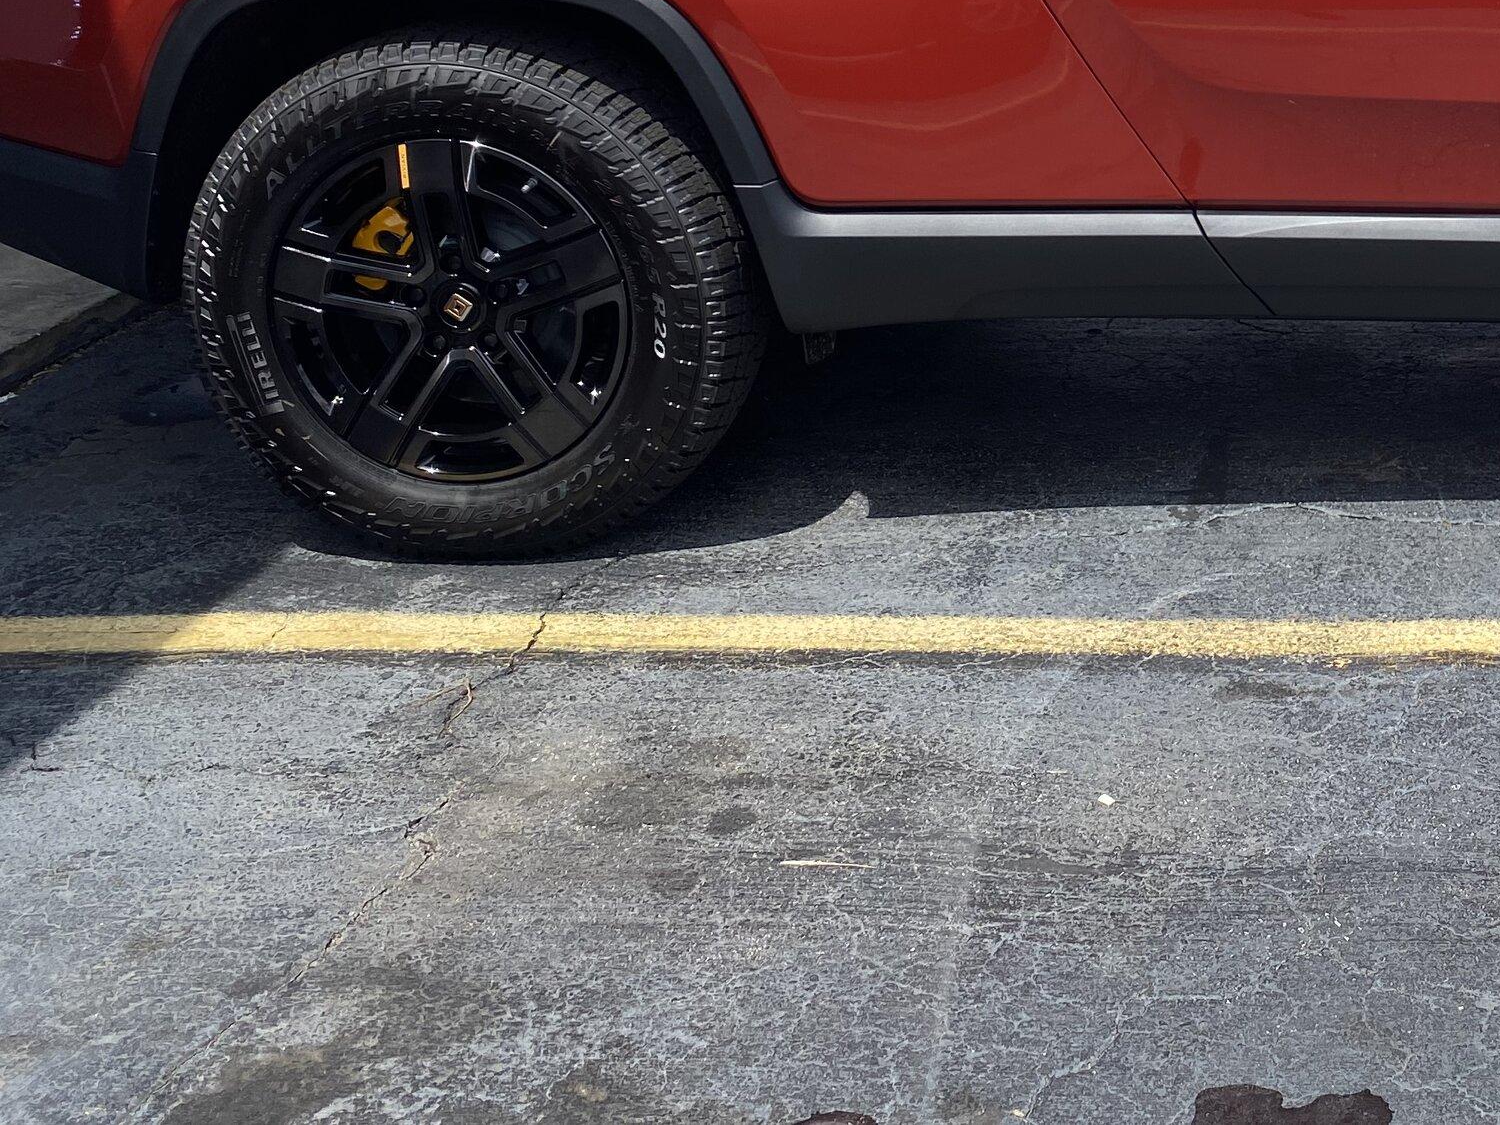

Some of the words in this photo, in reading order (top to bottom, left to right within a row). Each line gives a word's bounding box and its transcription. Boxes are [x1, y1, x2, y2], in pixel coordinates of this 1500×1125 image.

[225, 310, 285, 417] PIRELLI
[651, 292, 668, 359] R20
[384, 441, 617, 524] SCORPION
